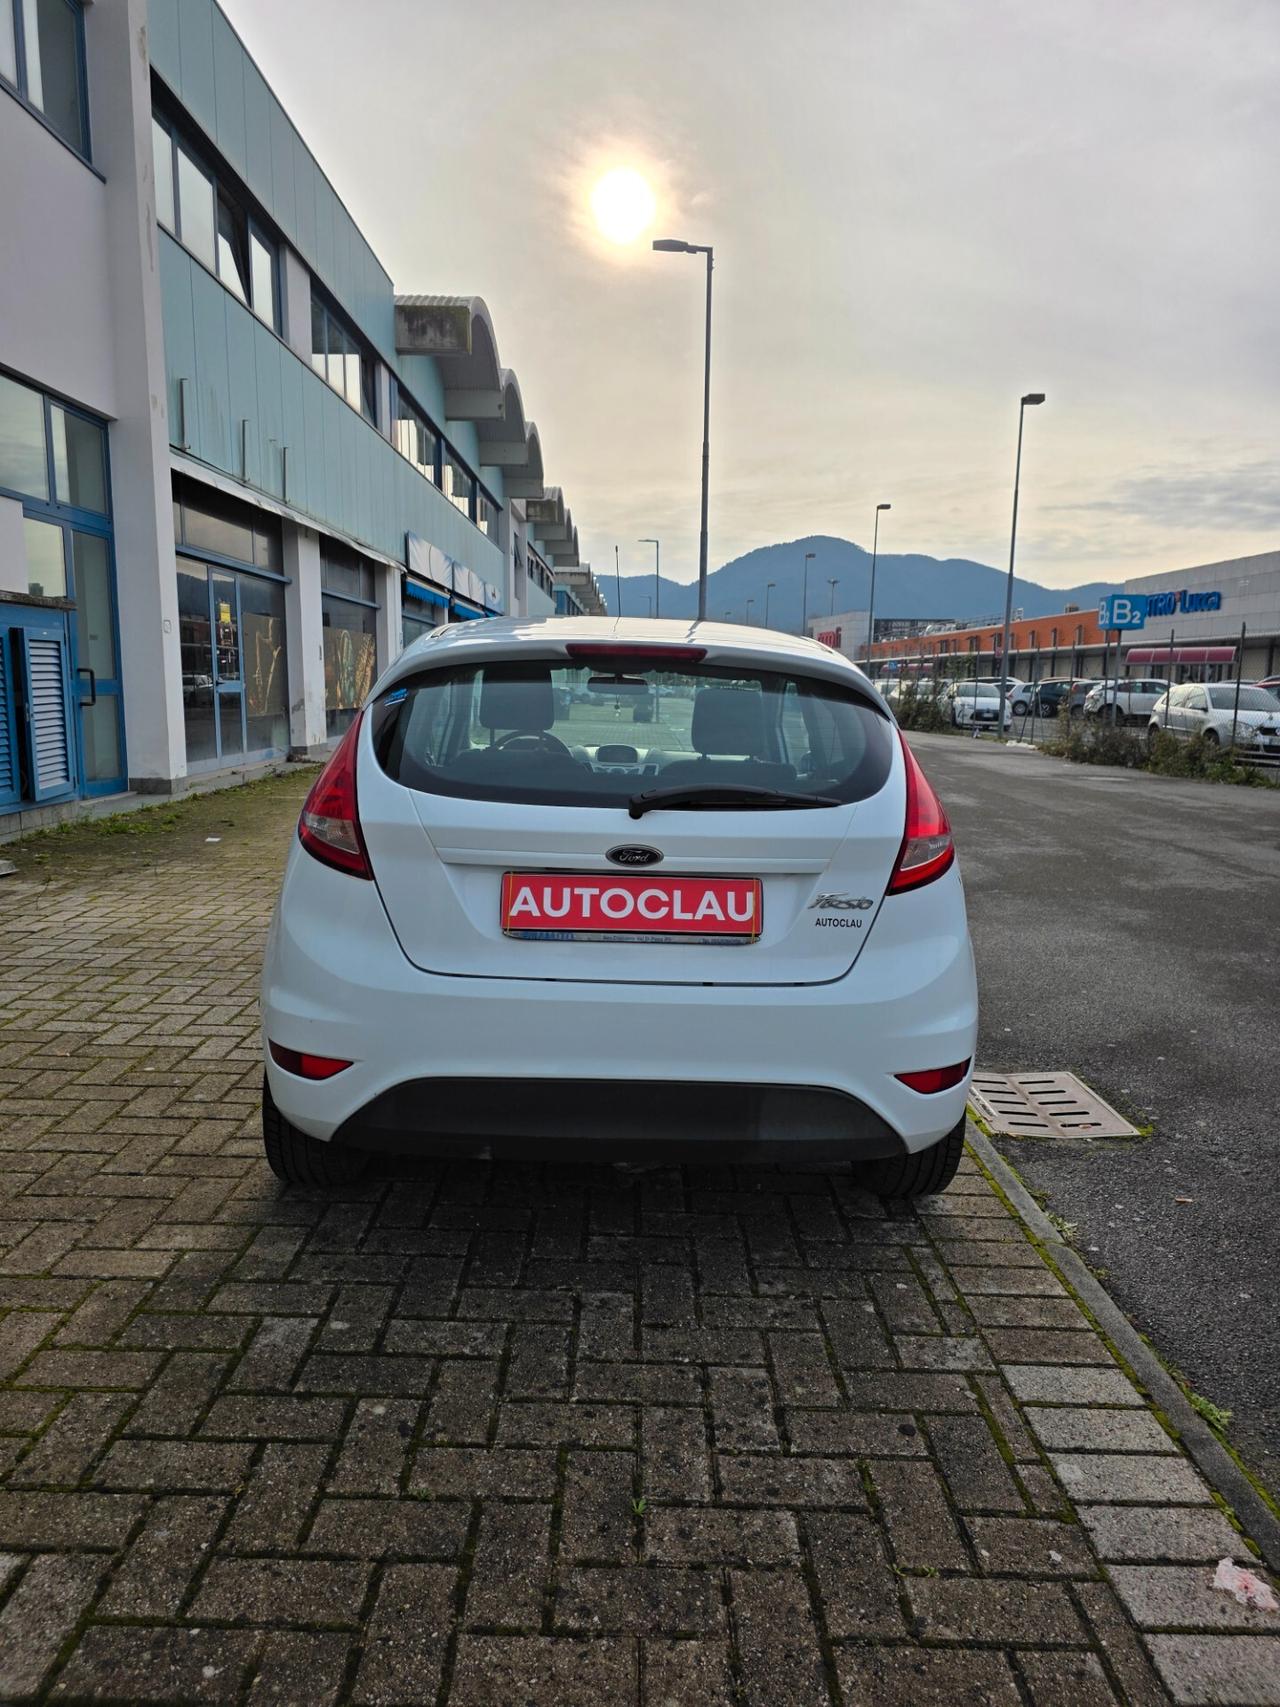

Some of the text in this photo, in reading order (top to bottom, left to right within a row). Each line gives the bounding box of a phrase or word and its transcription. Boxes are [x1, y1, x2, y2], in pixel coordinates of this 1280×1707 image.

[1112, 599, 1141, 624] B2
[619, 849, 650, 862] Ford
[509, 886, 754, 922] AUTOCLAU
[815, 917, 863, 928] AUTOCLAU
